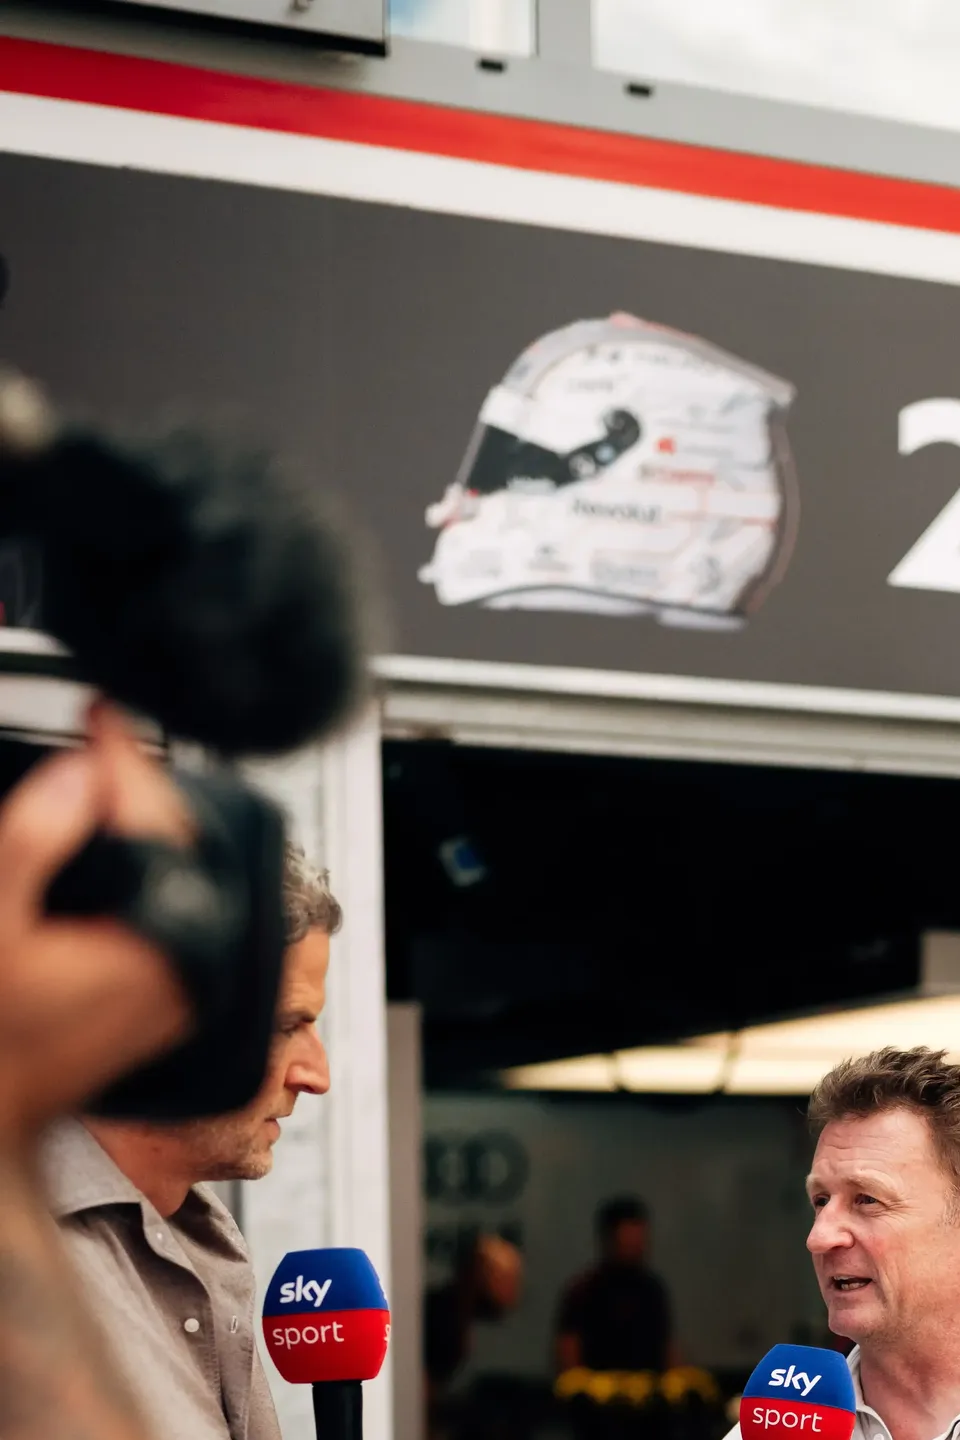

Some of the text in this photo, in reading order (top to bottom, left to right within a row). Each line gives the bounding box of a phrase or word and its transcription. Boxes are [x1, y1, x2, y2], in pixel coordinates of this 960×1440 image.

[280, 1275, 332, 1308] sky
[272, 1321, 345, 1350] sport
[768, 1364, 822, 1397] sky
[752, 1407, 823, 1433] sport
